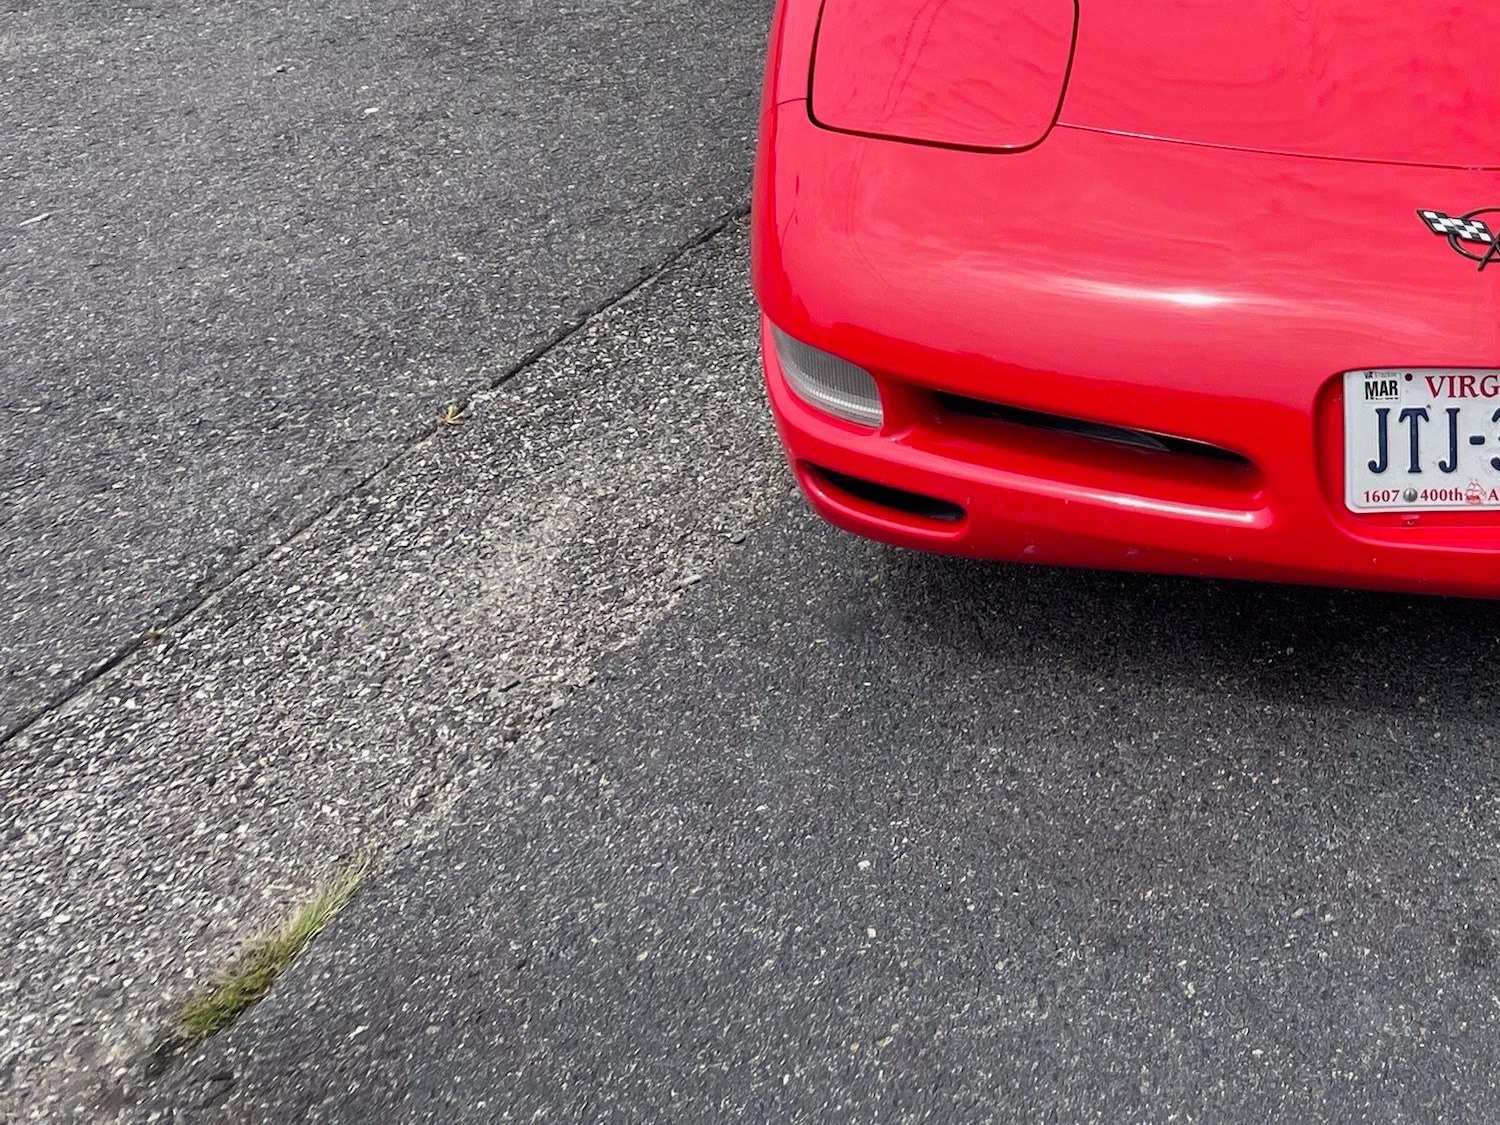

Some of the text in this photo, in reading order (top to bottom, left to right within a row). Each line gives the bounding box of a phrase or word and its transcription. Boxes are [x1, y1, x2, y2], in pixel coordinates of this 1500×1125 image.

[1365, 380, 1398, 398] MAR
[1364, 490, 1400, 503] 1607
[1420, 487, 1463, 502] 400th
